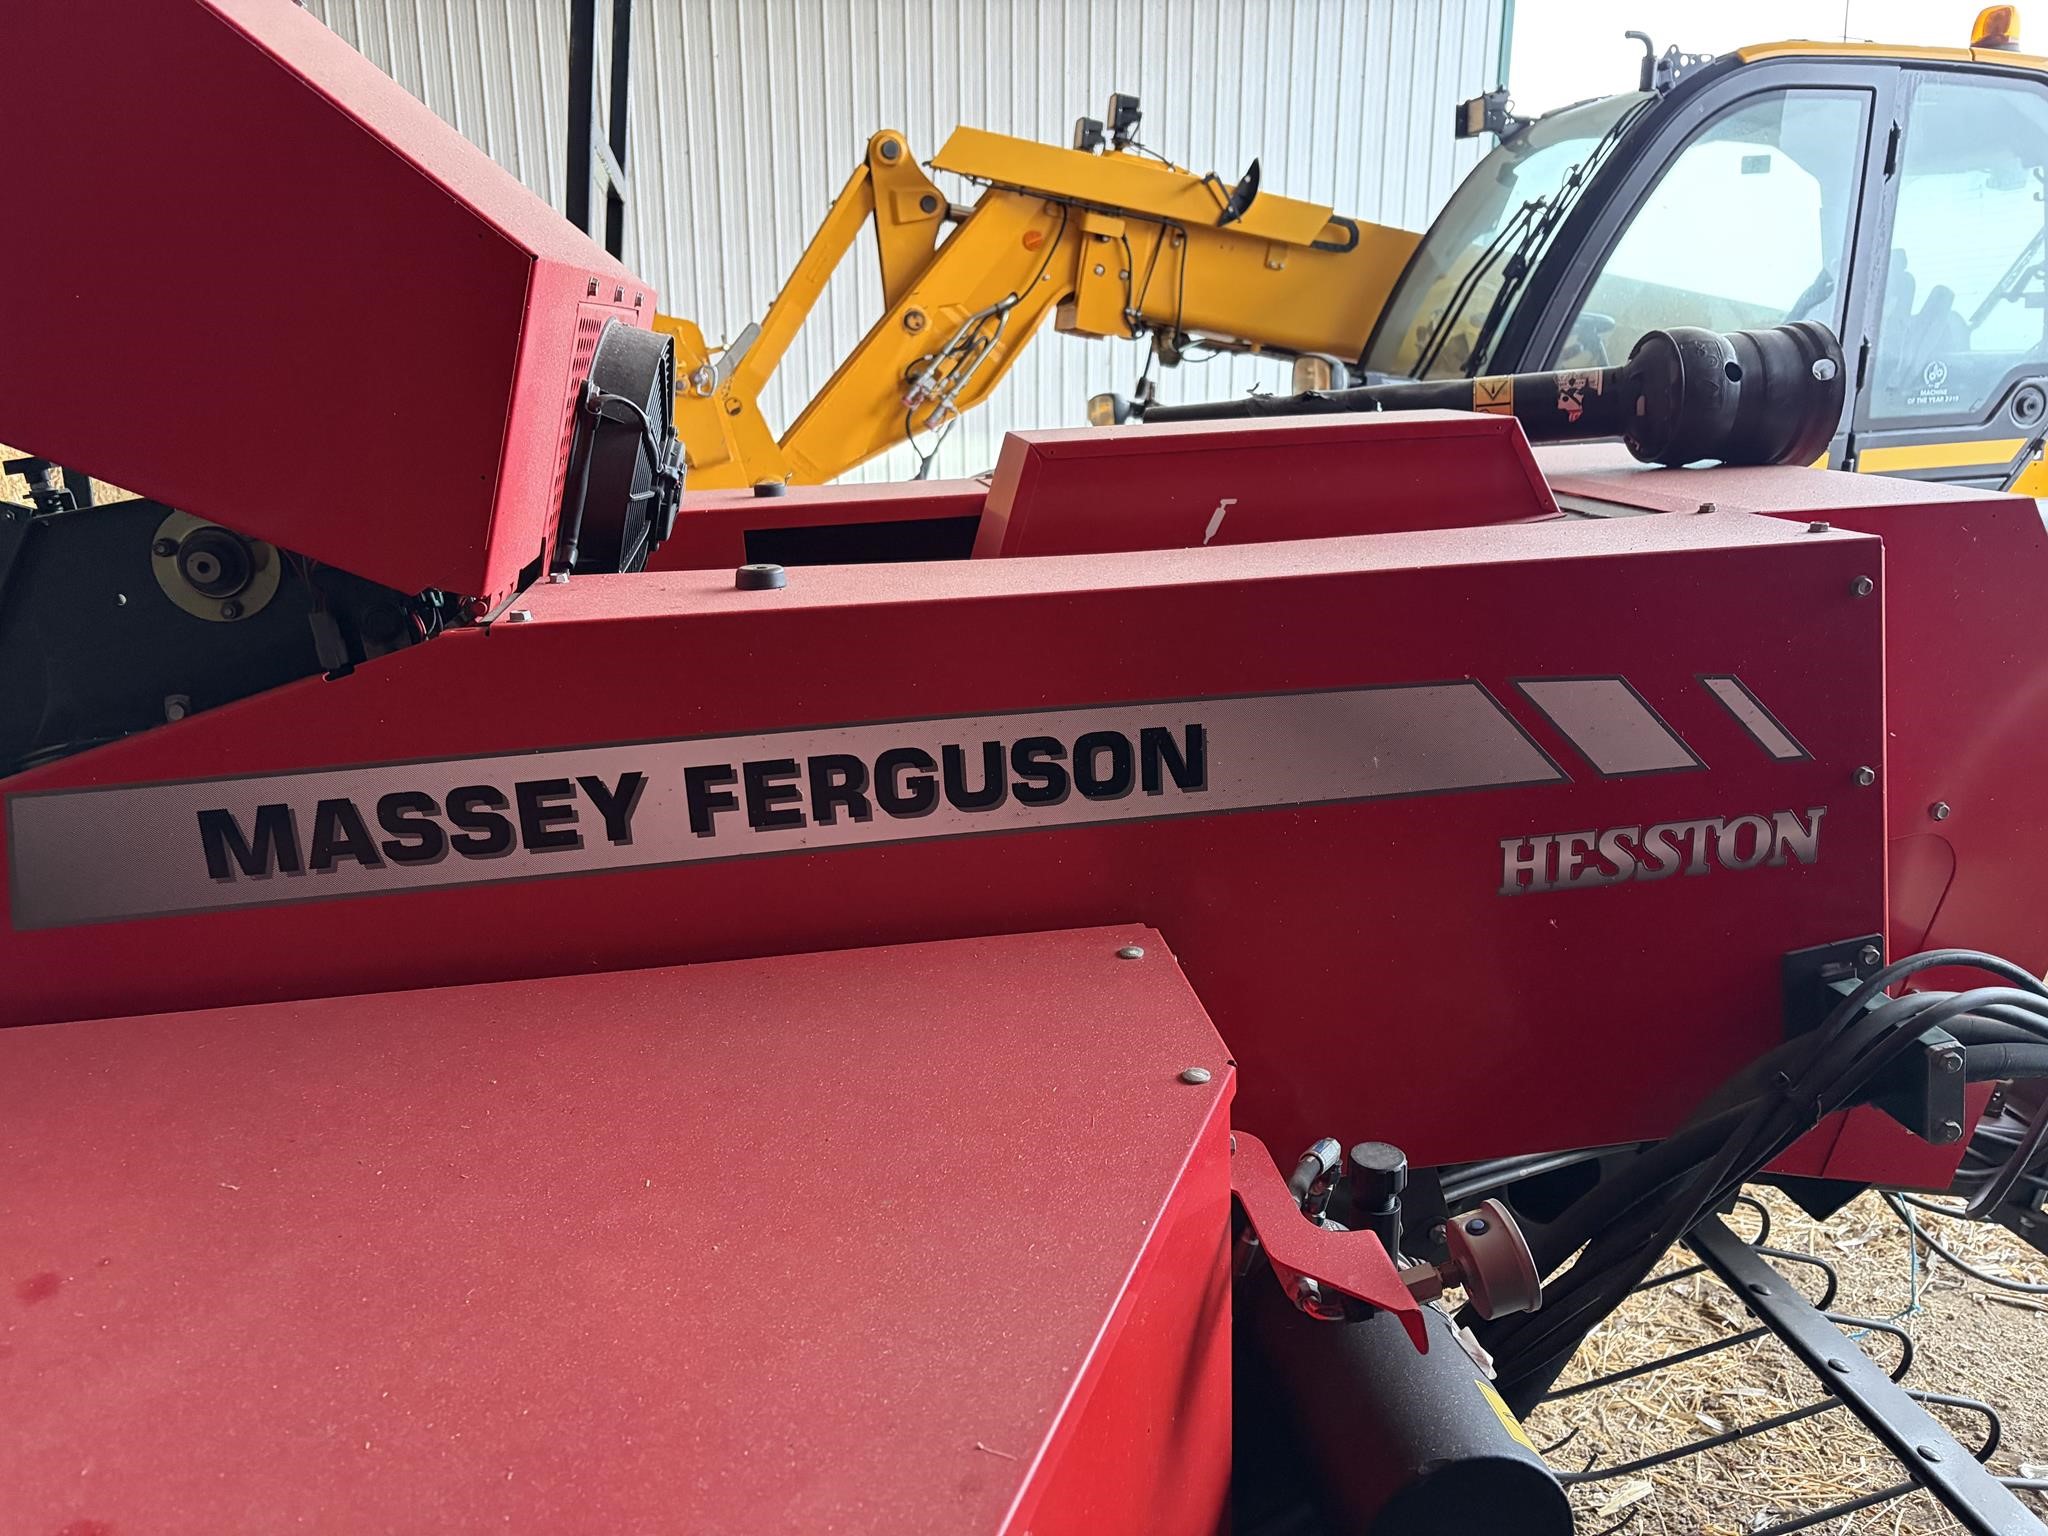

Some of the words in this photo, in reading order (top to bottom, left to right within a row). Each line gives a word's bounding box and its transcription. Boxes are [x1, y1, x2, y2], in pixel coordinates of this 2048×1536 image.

[1929, 396, 1944, 404] YEAR
[197, 771, 649, 882] MASSEY
[684, 724, 1208, 837] FERGUSON
[1498, 806, 1827, 896] HESSTON
